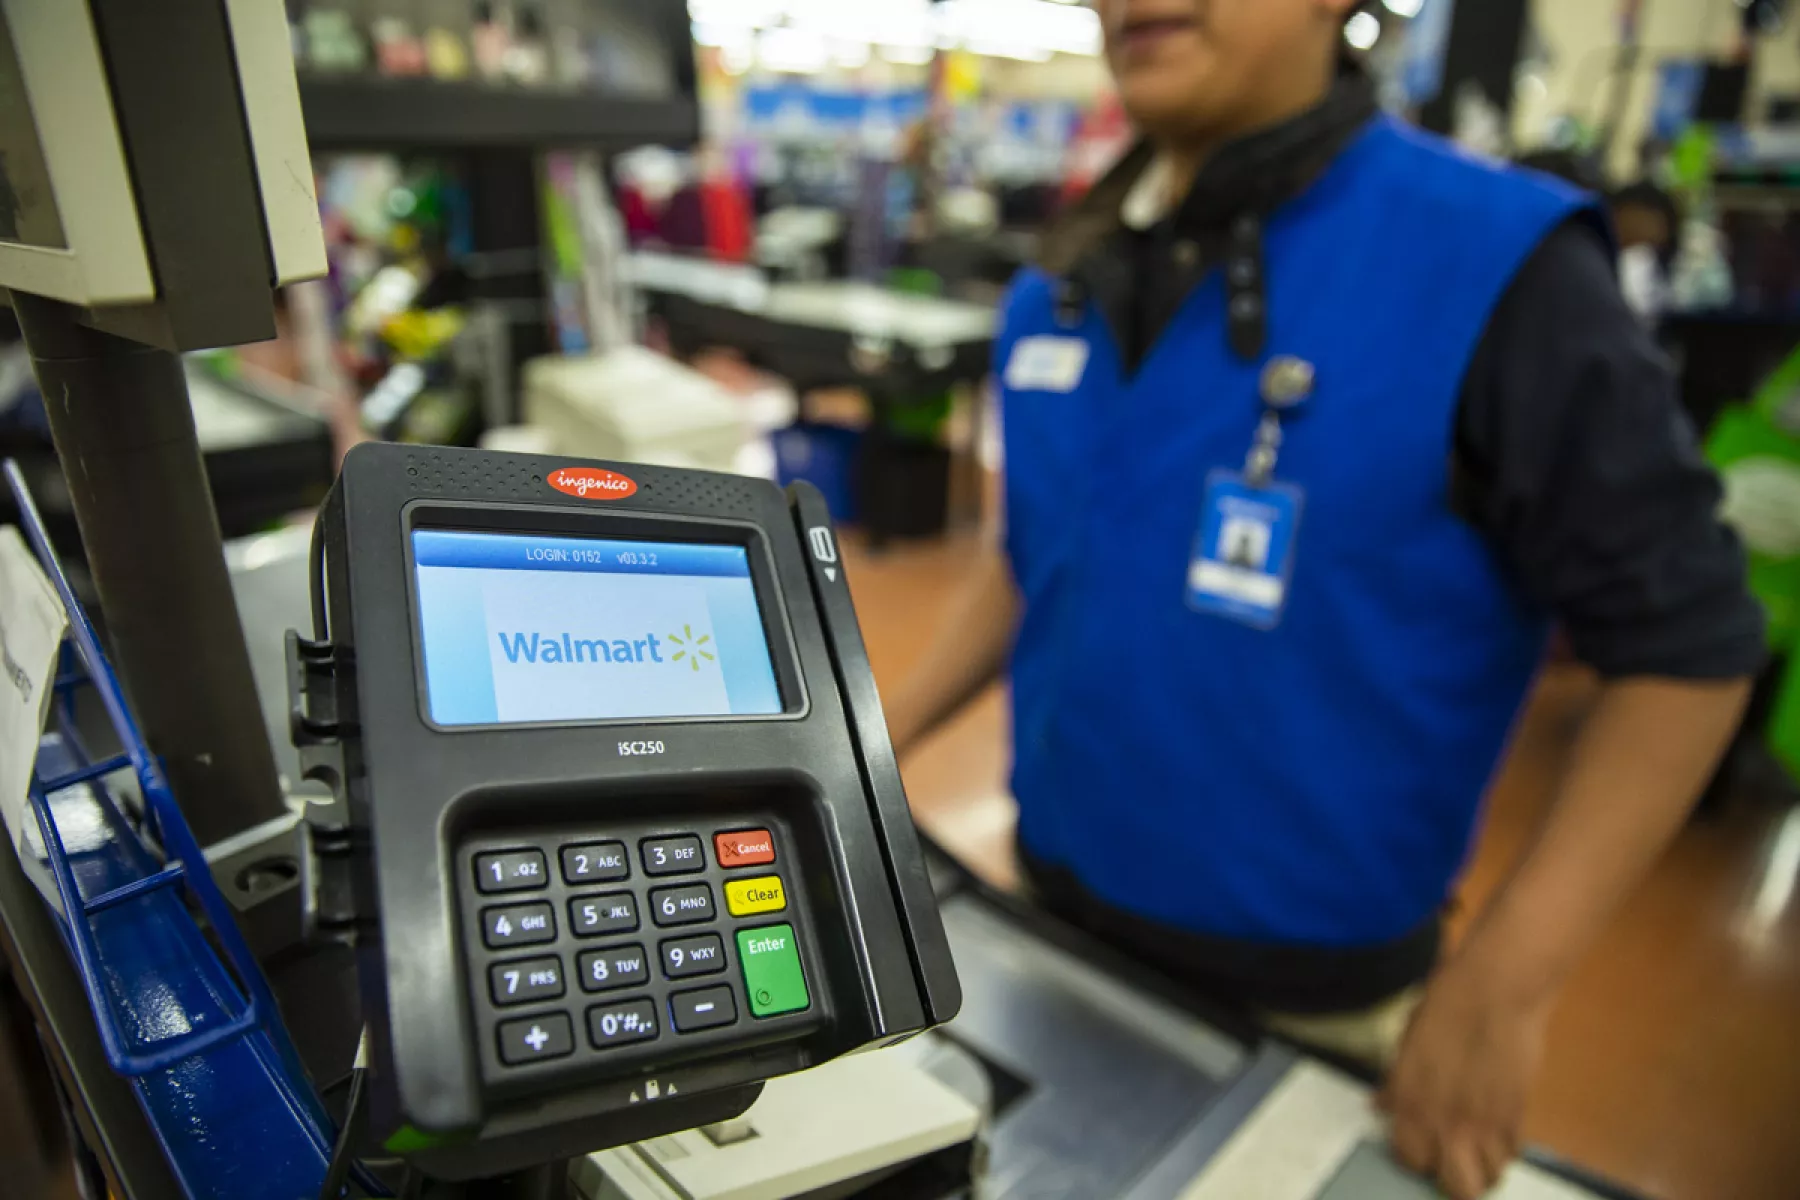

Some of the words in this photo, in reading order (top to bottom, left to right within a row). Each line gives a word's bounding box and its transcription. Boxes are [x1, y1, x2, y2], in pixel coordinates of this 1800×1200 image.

[557, 471, 629, 496] ingenico
[526, 547, 571, 563] LOGIN:
[572, 549, 601, 564] 0152
[498, 632, 664, 663] Walmart
[617, 740, 665, 756] iSC250
[653, 847, 666, 865] 3
[675, 847, 695, 859] DEF
[738, 842, 770, 854] Cancel
[491, 861, 502, 881] 1
[575, 855, 588, 874] 2
[599, 855, 621, 868] ABC
[747, 888, 779, 902] Clear
[583, 905, 598, 925] 5
[610, 905, 630, 919] JKL
[662, 897, 676, 915] 6
[680, 896, 706, 909] MNO
[495, 915, 512, 936] 4
[521, 914, 546, 930] GHI
[748, 938, 786, 954] Enter
[670, 947, 684, 967] 9
[690, 946, 715, 960] WXY
[593, 959, 608, 981] 8
[615, 958, 640, 973] TUV
[504, 971, 520, 993] 7
[529, 969, 557, 986] PRS
